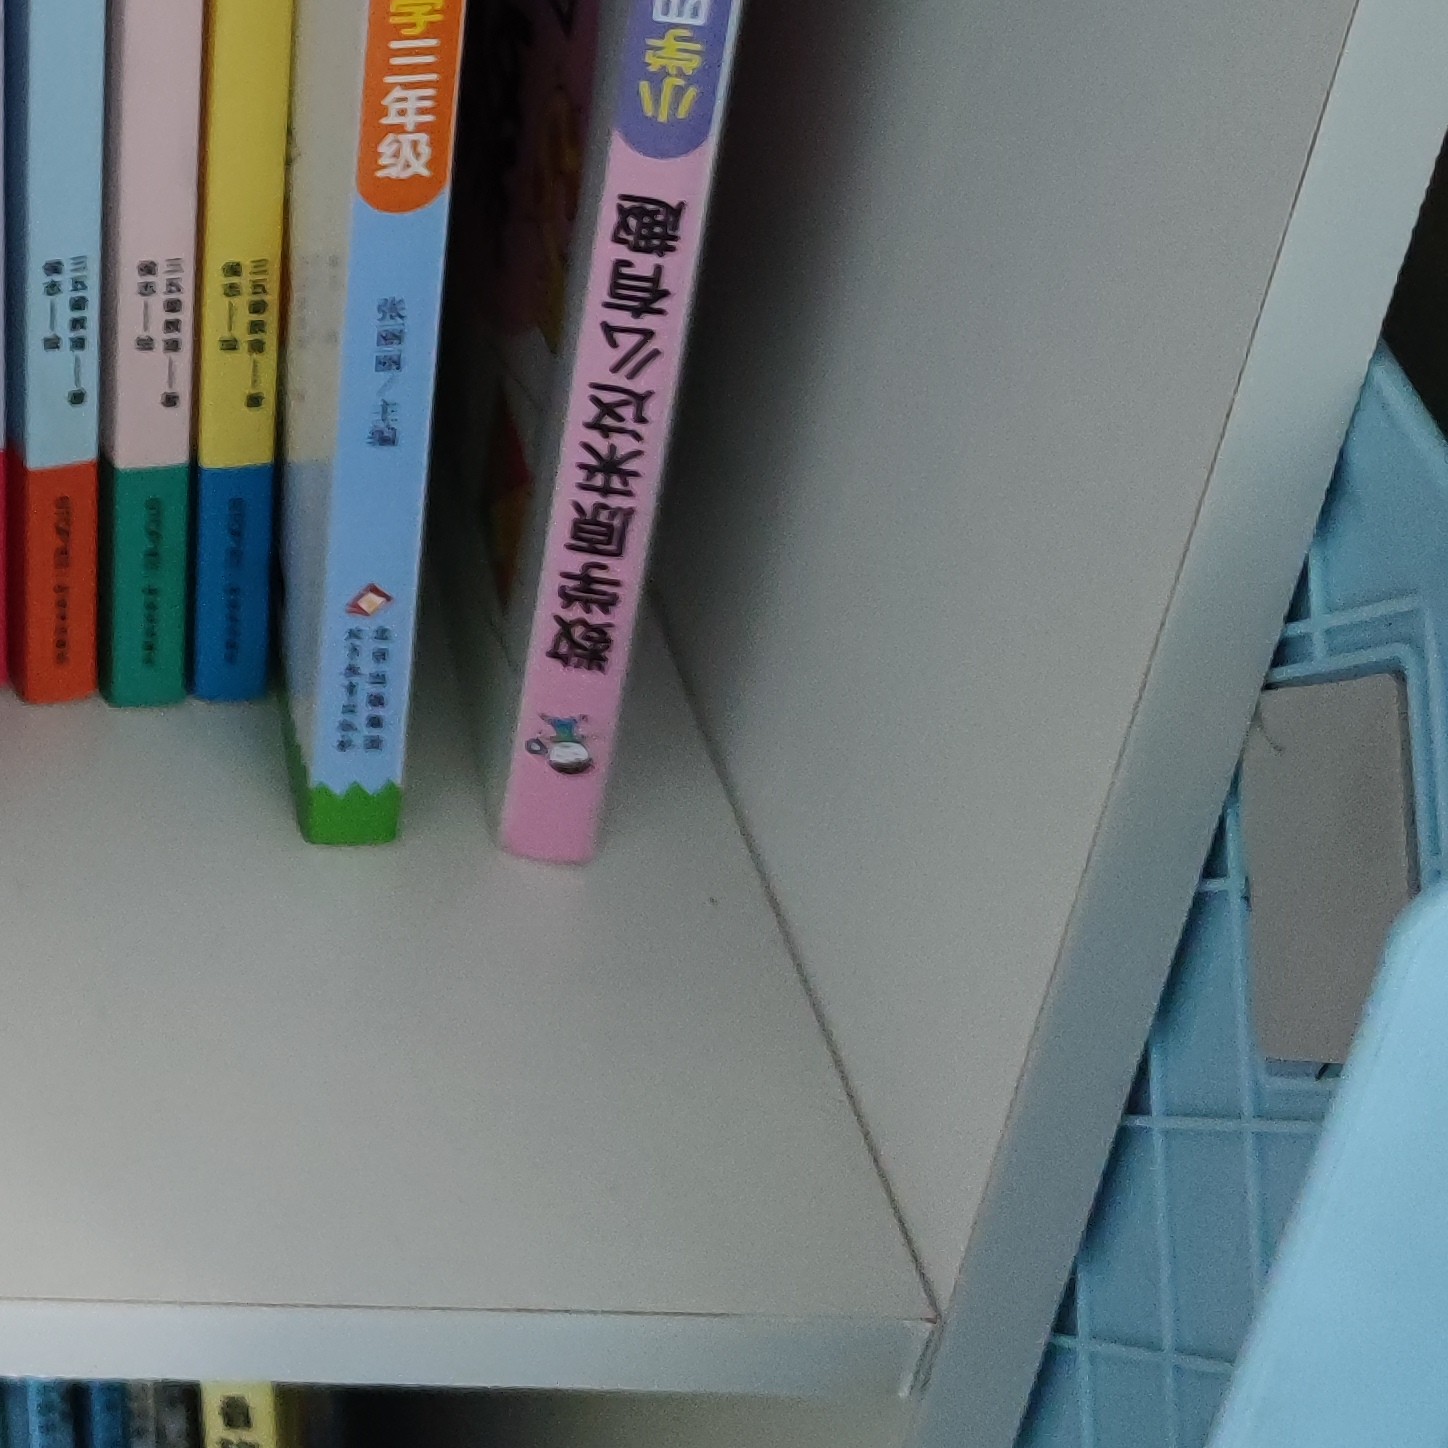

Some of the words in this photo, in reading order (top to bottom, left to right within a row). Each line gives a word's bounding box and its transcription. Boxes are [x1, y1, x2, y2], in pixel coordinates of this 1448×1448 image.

[544, 193, 687, 674] 数学原来这么有趣
